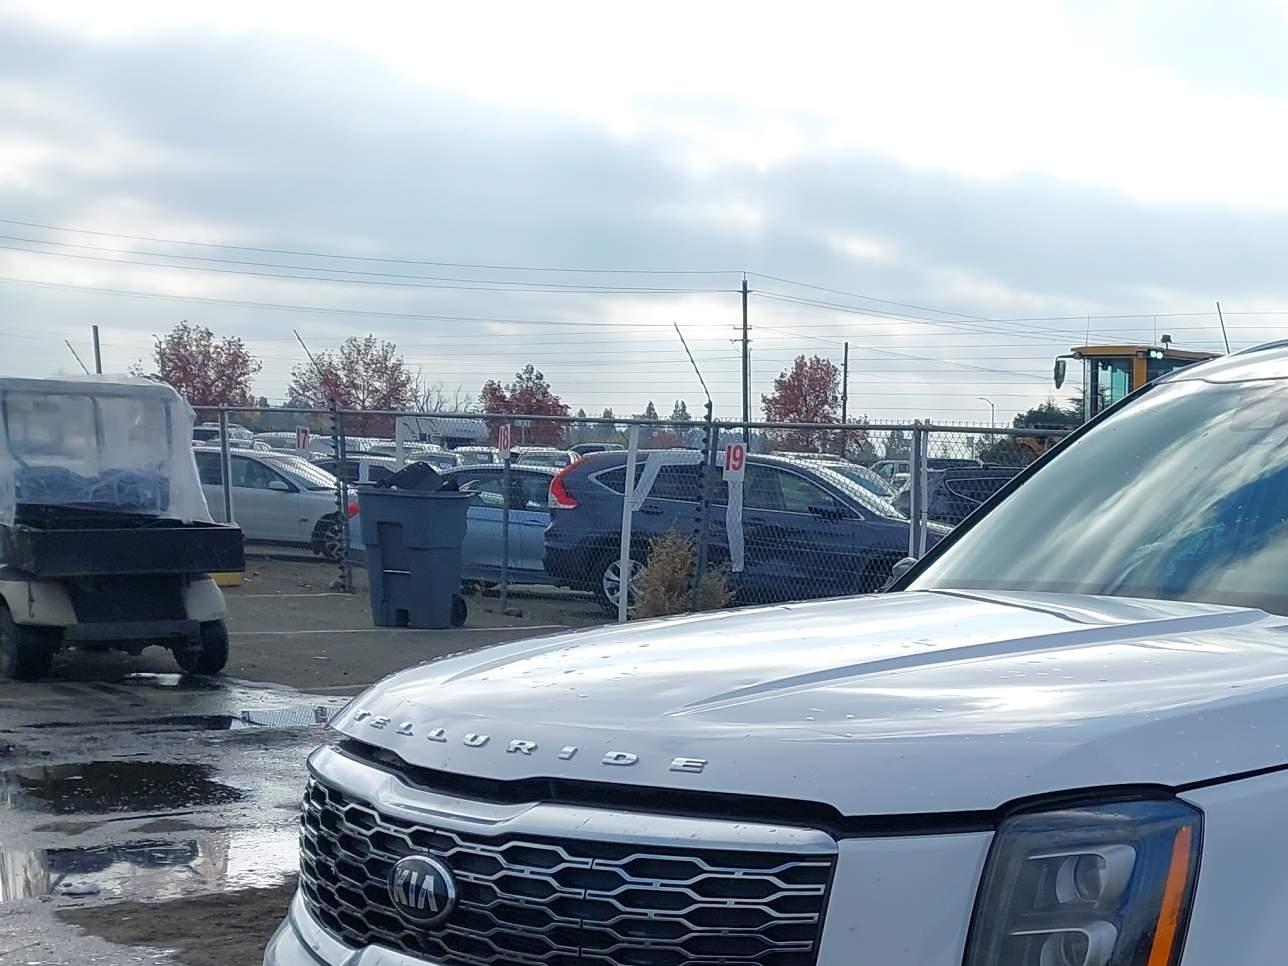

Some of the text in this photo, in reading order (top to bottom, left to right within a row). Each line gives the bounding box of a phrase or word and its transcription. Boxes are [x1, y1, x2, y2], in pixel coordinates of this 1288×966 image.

[297, 427, 308, 449] 17
[725, 445, 744, 471] 19
[353, 708, 709, 774] TELLURIDE
[394, 866, 438, 912] KIA
